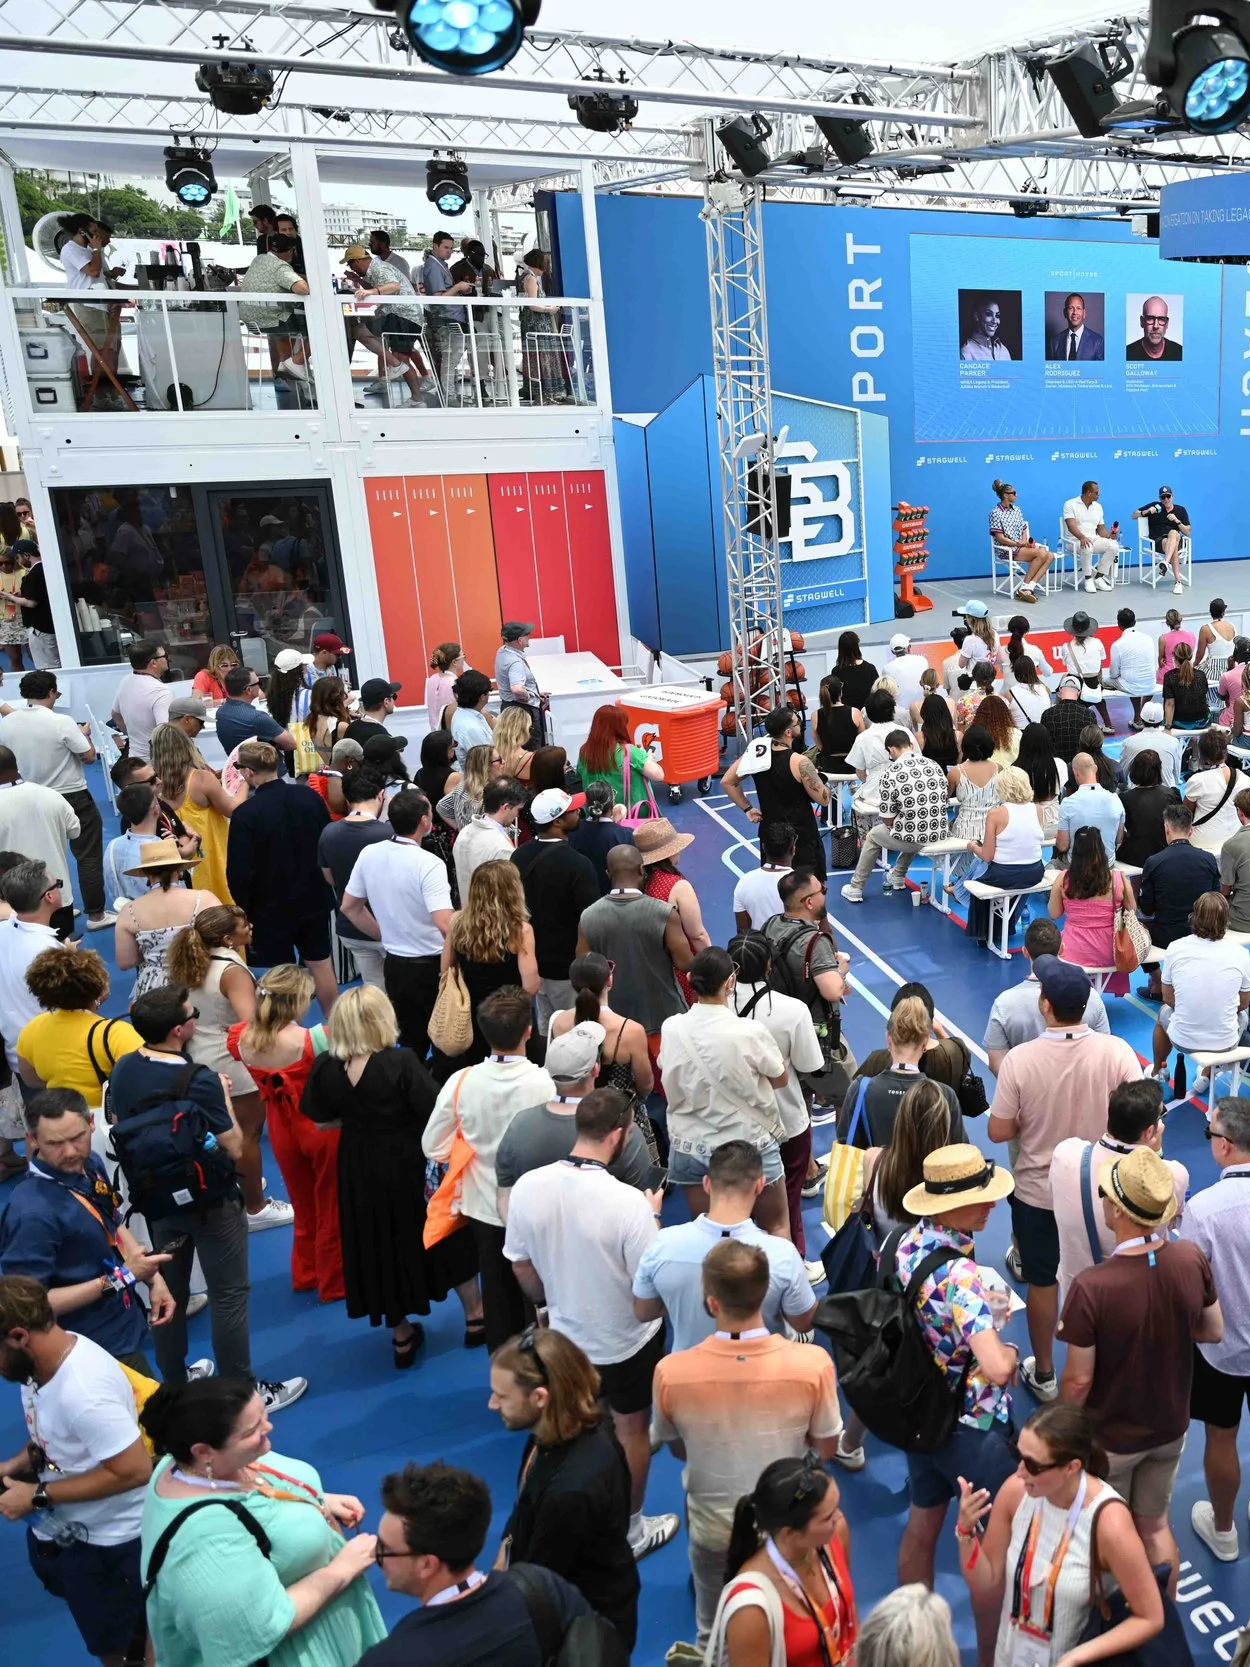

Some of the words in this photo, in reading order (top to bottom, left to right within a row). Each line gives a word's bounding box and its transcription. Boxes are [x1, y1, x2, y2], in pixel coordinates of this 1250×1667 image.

[1201, 208, 1225, 224] TAKING
[1060, 451, 1098, 460] STAGWELL
[1123, 450, 1159, 458] STAGWELL
[1183, 449, 1218, 457] STAGWELL
[927, 456, 968, 465] STAGWELL
[995, 454, 1035, 463] STAGWELL
[796, 588, 845, 604] STAGWELL
